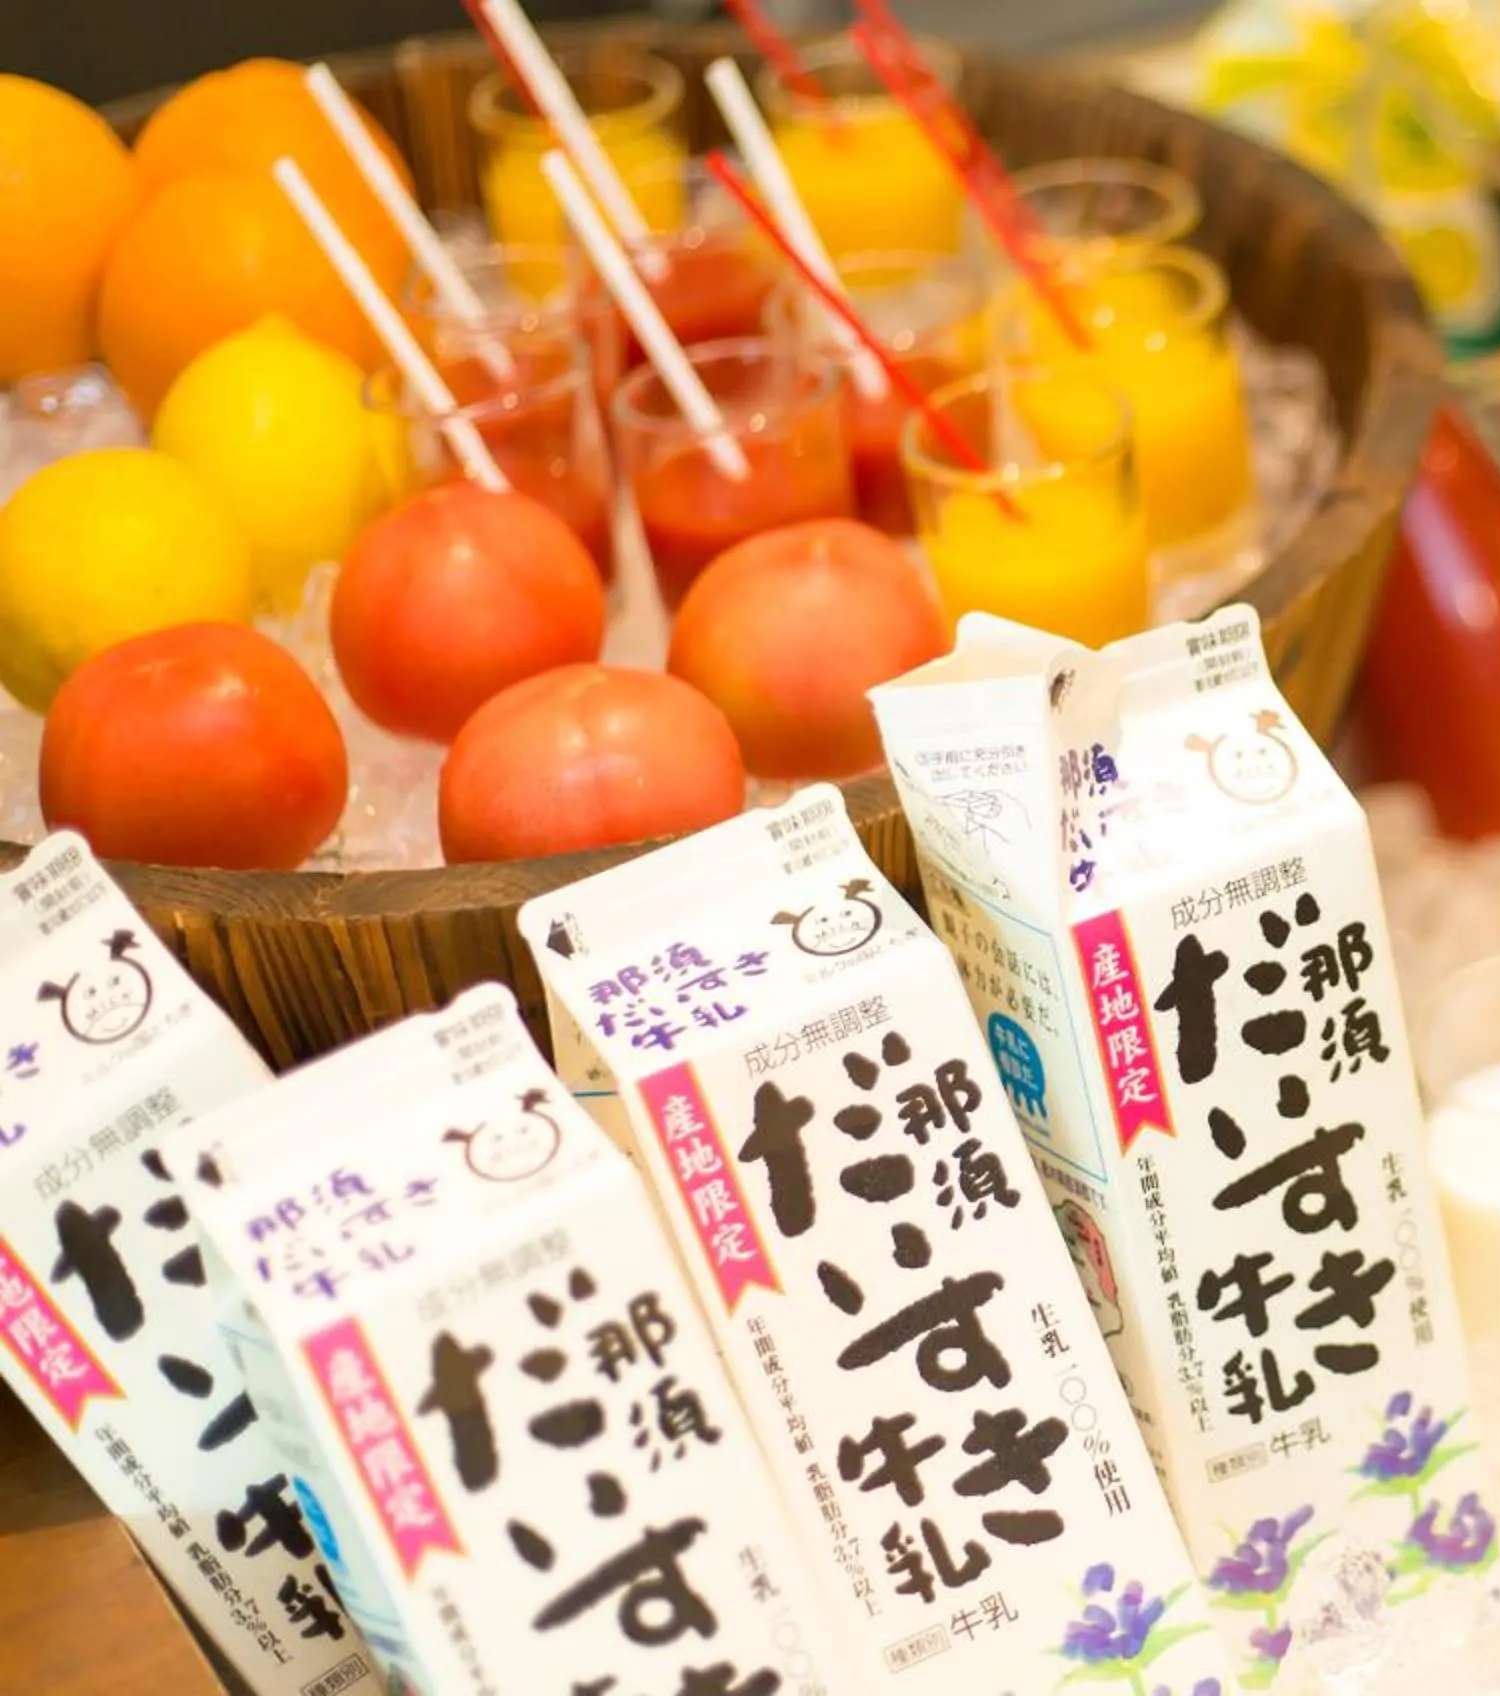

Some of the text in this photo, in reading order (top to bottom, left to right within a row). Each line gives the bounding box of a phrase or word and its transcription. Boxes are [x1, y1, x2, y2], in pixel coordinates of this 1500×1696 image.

[1171, 857, 1309, 931] 成分無調整
[631, 1001, 748, 1051] 牛乳
[743, 994, 895, 1079] 成分無調整
[1091, 941, 1159, 1107] 産地限定
[1301, 921, 1391, 1084] 那須
[663, 1094, 758, 1266] 産地限定
[896, 1058, 1021, 1230] 那須
[586, 1289, 723, 1474] 那須
[1195, 1251, 1315, 1425] 牛乳
[837, 1411, 992, 1604] 牛乳
[1269, 1416, 1332, 1459] 牛乳
[949, 1592, 1020, 1642] 牛乳
